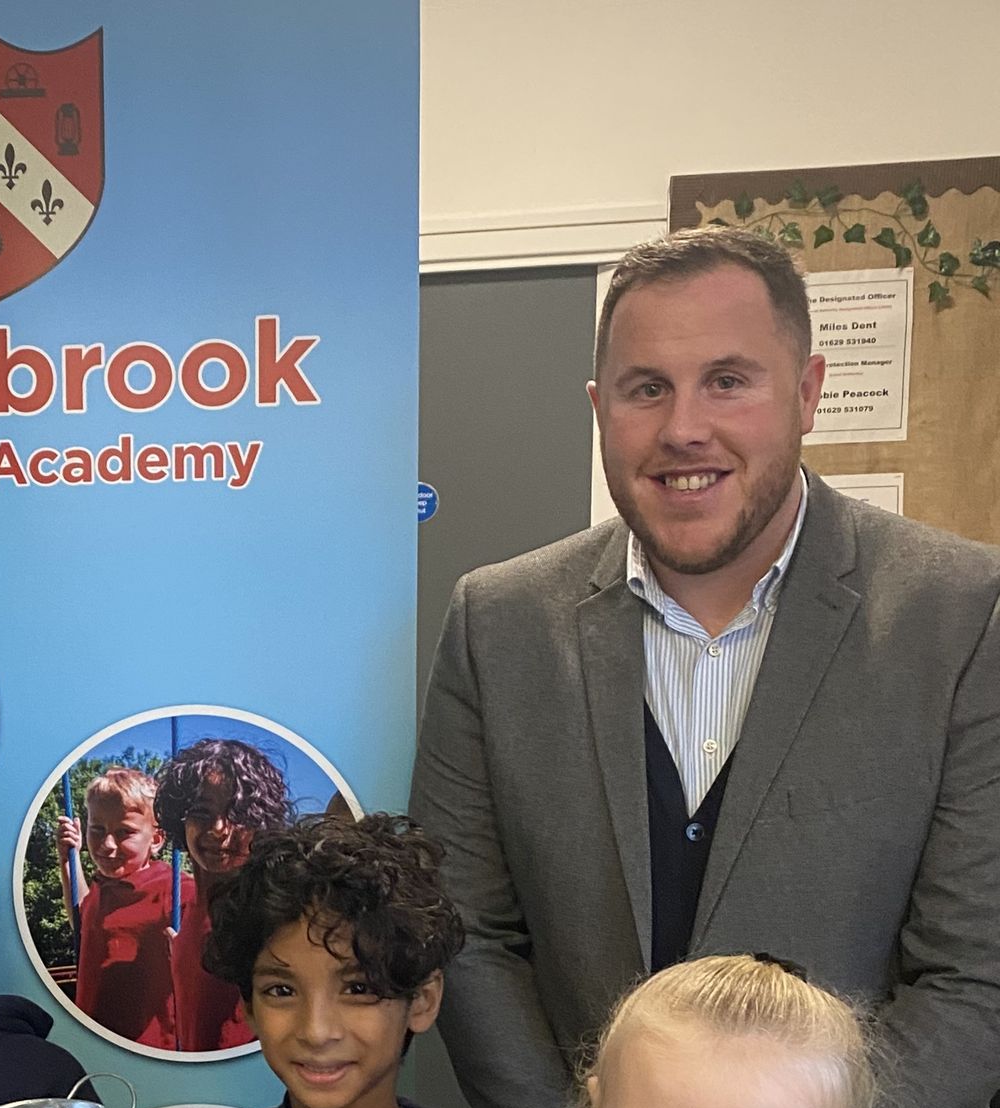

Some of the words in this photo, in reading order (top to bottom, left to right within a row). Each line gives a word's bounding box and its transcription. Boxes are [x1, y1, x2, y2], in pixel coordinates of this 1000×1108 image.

[819, 294, 866, 303] Designated
[819, 322, 848, 332] Miles
[842, 388, 889, 398] Peacock
